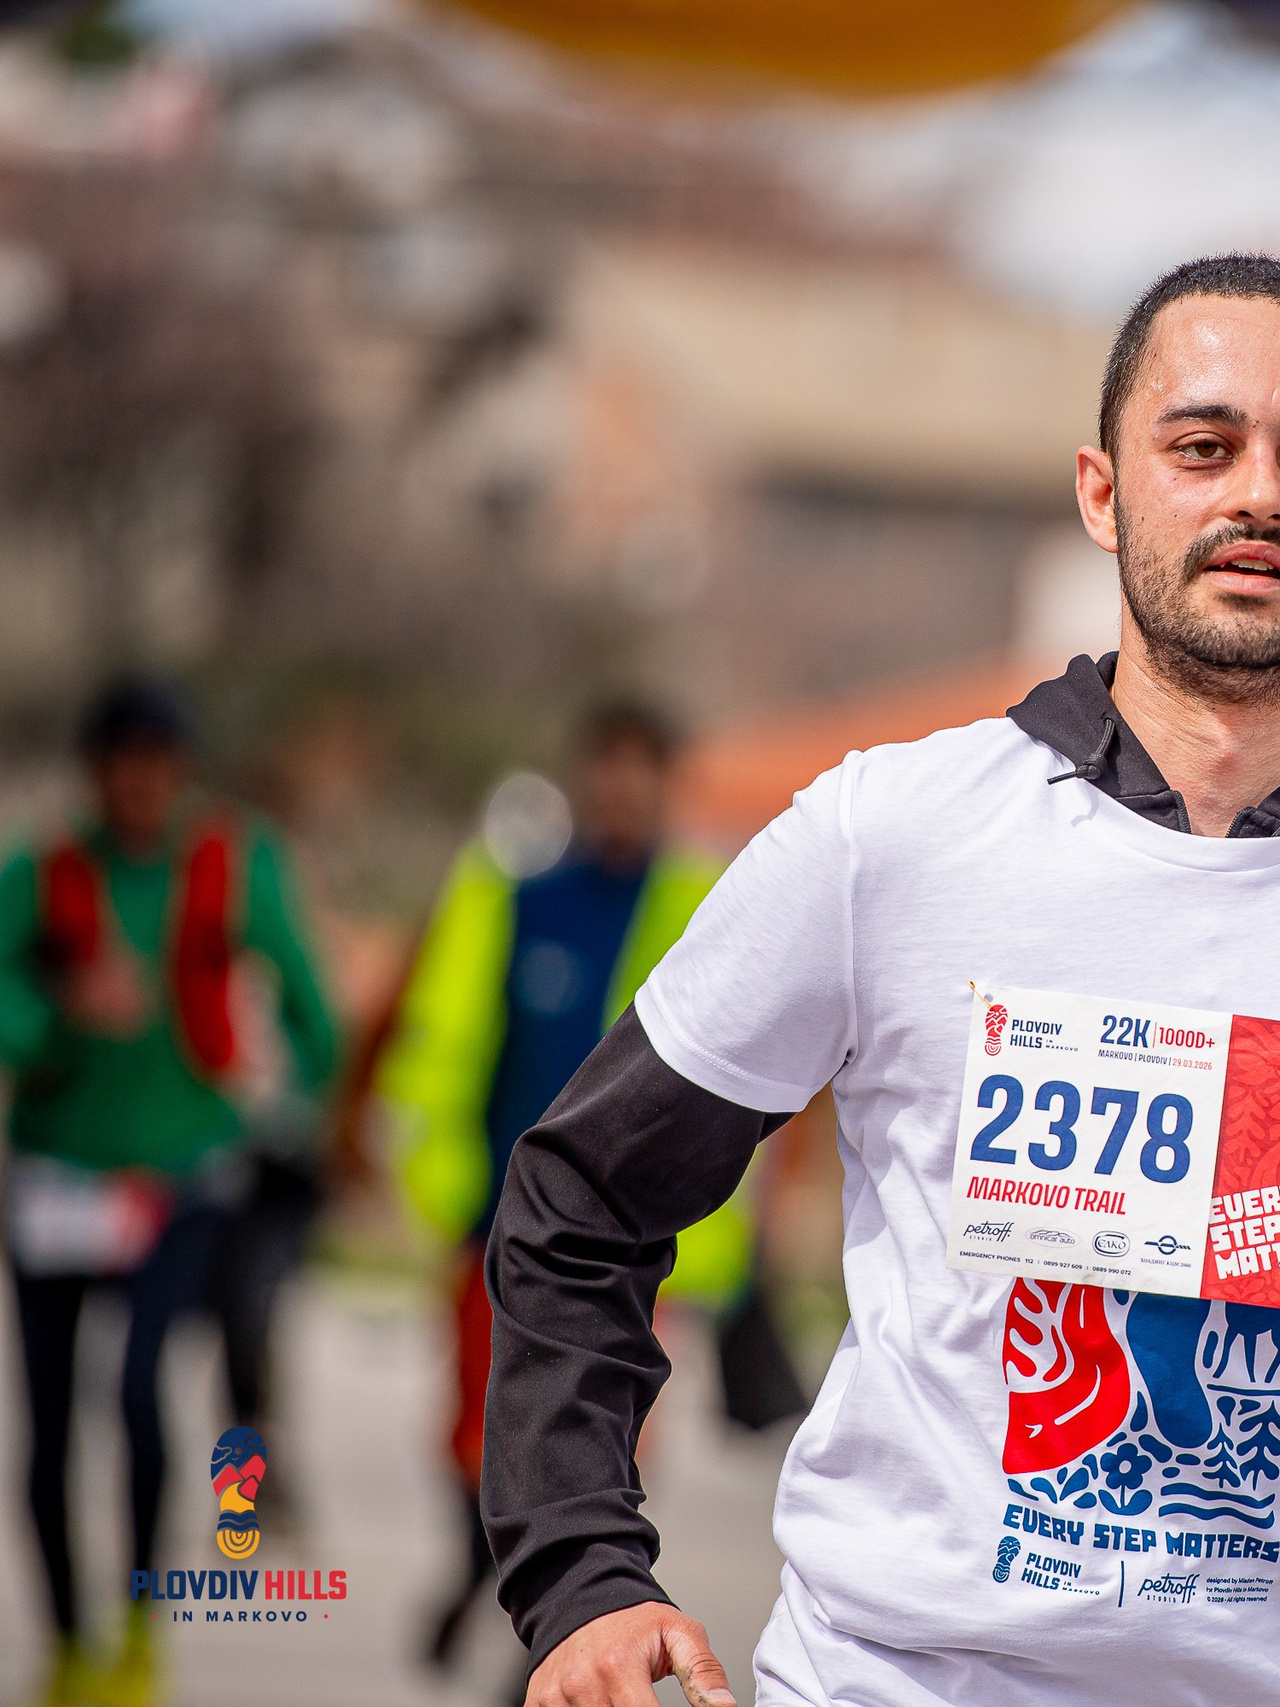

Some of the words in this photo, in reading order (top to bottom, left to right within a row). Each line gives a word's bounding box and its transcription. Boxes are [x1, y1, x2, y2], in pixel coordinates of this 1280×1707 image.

[1011, 1018, 1063, 1035] PLOVDIV
[1100, 1014, 1151, 1048] 22K
[1159, 1026, 1216, 1049] 1000D+
[1009, 1033, 1043, 1049] HILLS
[1097, 1049, 1133, 1061] MARKOVO
[1138, 1053, 1168, 1065] PLOVDIV
[1172, 1057, 1213, 1071] 29.03.2026
[970, 1074, 1194, 1184] 2378
[966, 1176, 1071, 1211] MARKOVO
[1074, 1187, 1127, 1216] TRAIL
[1059, 1236, 1076, 1245] auto
[959, 1250, 995, 1260] EMERGENCY
[996, 1254, 1021, 1263] PHONES
[1003, 1503, 1085, 1546] EVERY
[1093, 1523, 1157, 1552] STEP
[1165, 1531, 1280, 1564] MATTERS
[1025, 1552, 1082, 1579] PLOVDIV
[1020, 1567, 1061, 1591] HILLS
[1062, 1587, 1100, 1596] MARKOVO
[1146, 1594, 1177, 1603] STUDIO
